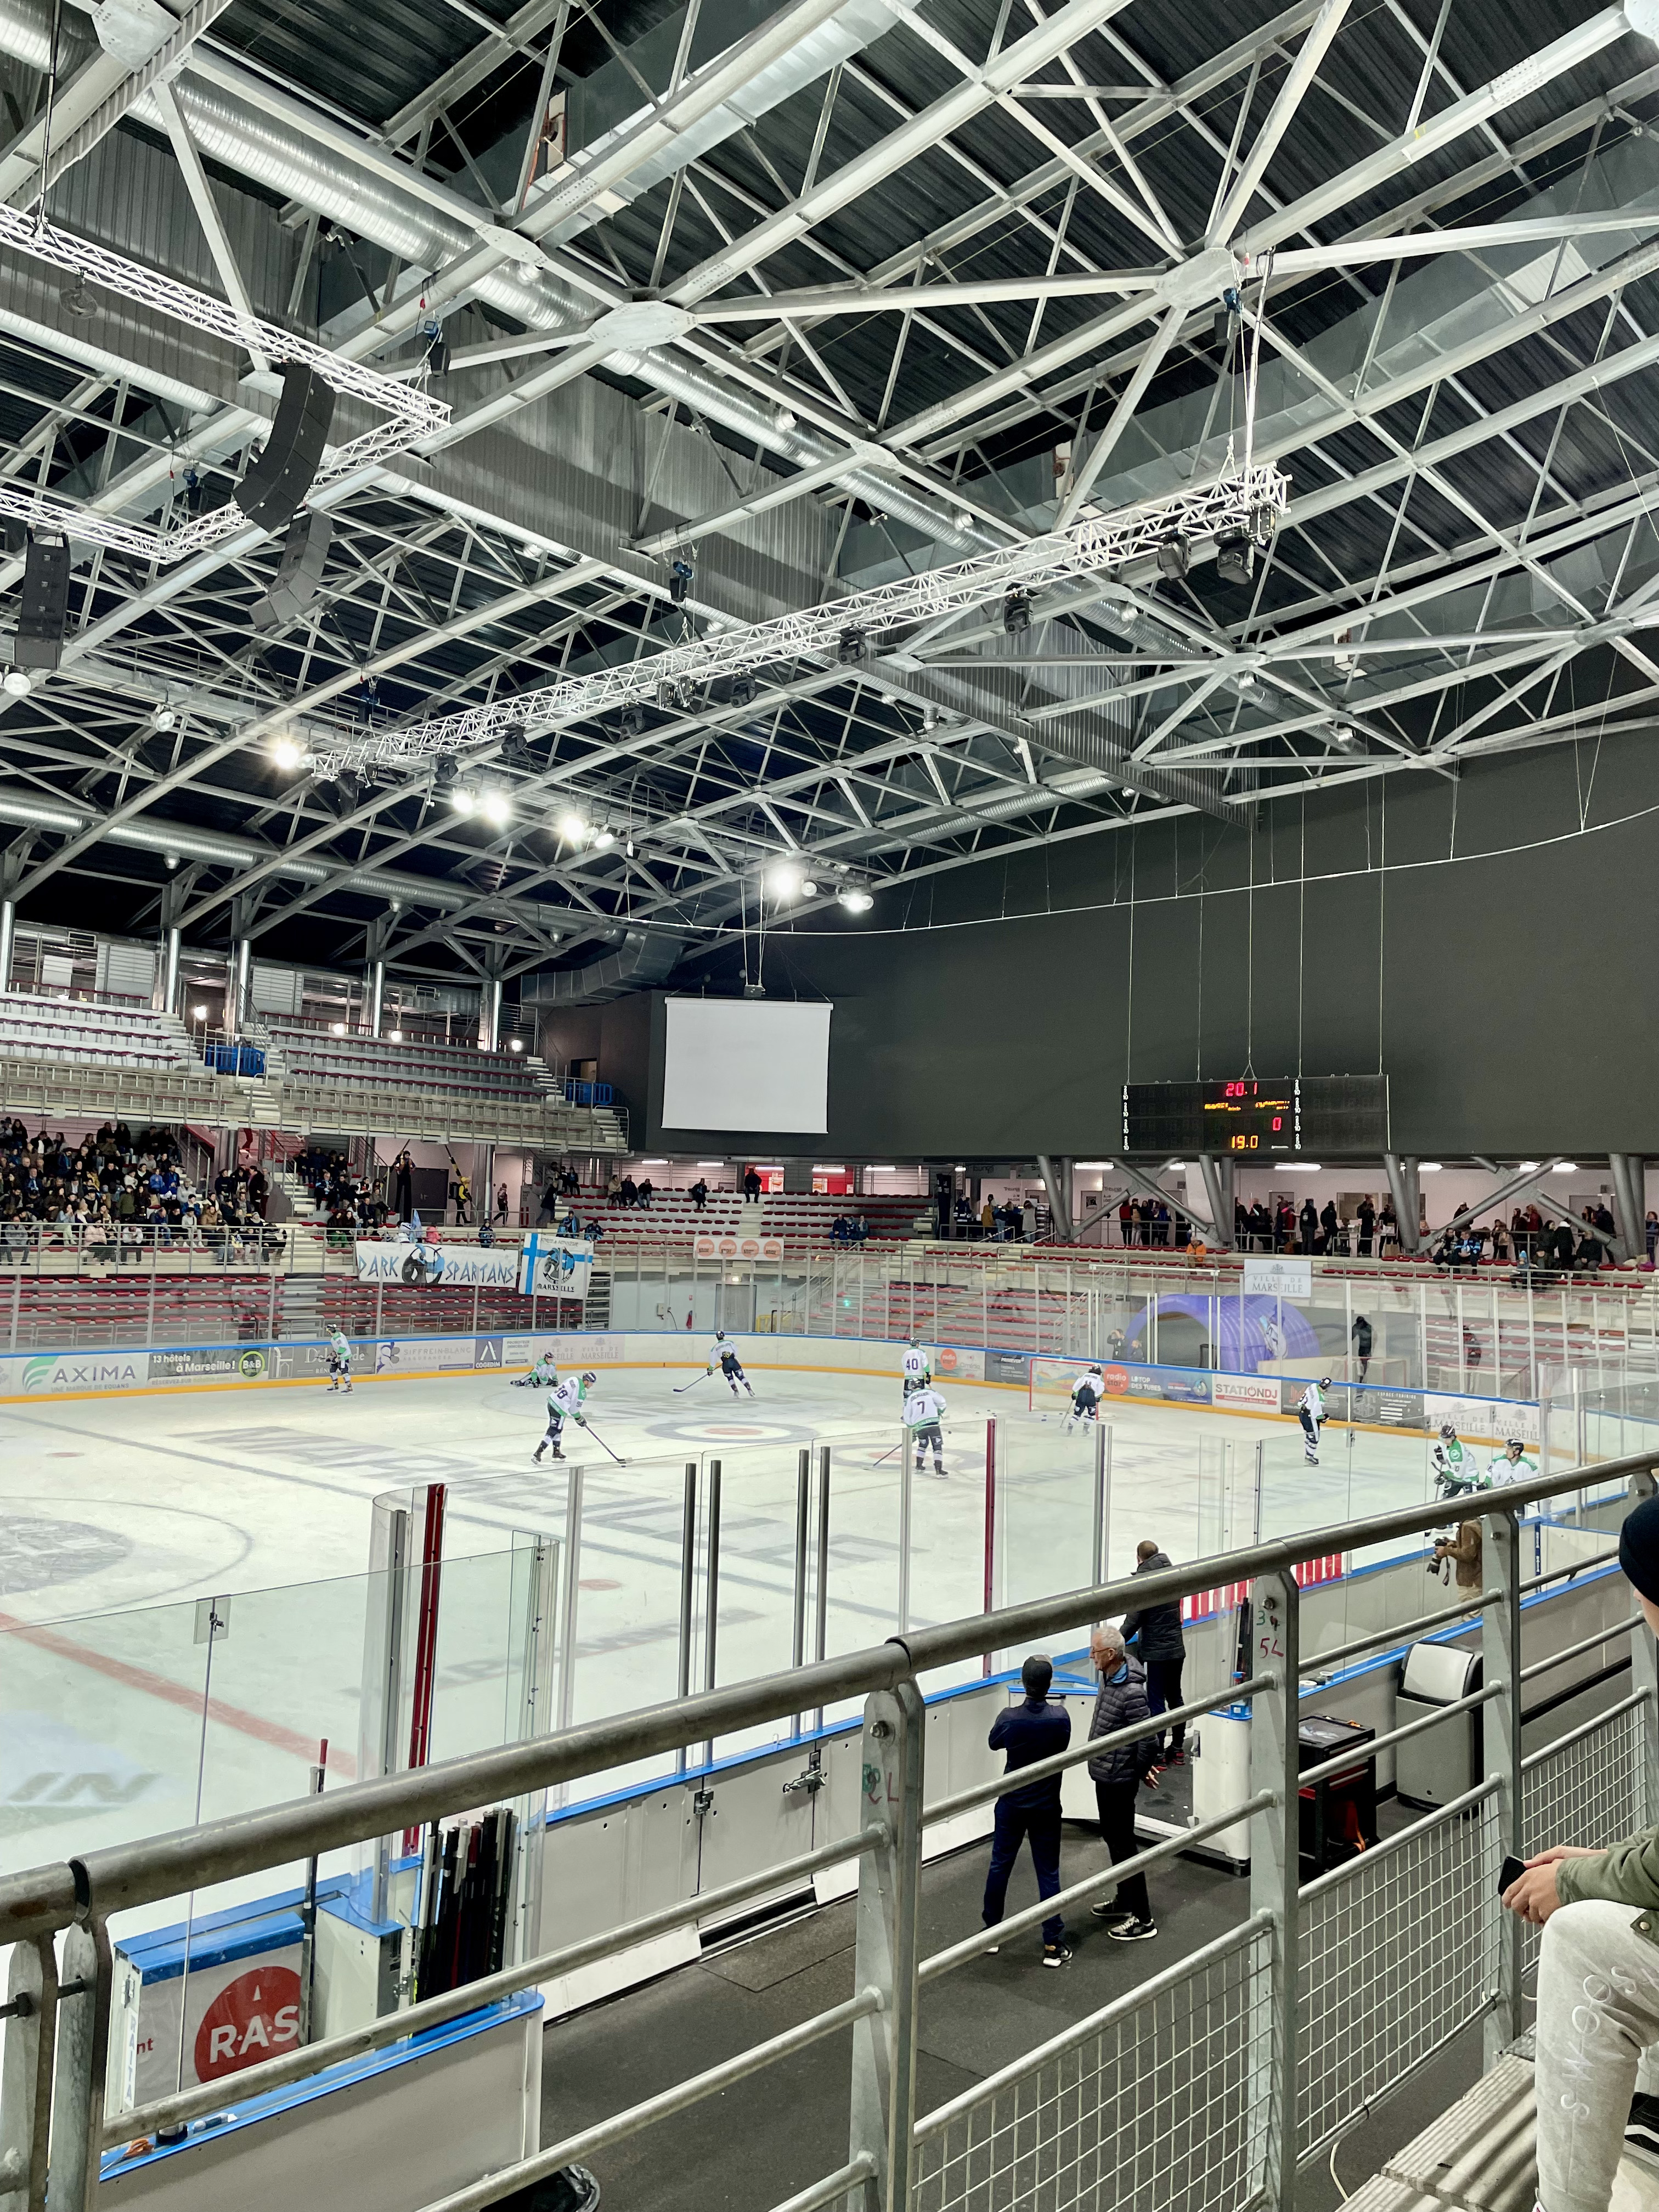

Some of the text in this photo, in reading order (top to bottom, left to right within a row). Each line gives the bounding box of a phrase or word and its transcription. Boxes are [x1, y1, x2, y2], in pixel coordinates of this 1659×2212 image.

[1272, 1116, 1282, 1131] 0
[1232, 1135, 1259, 1149] 19.0
[445, 1260, 515, 1284] SPARTANS
[153, 1354, 191, 1363] 13 hôtels
[580, 1351, 619, 1360] MARSEILLE
[176, 1364, 184, 1373] à
[185, 1360, 235, 1372] Marseille!
[242, 1359, 262, 1369] B&B
[906, 1358, 918, 1370] 40
[52, 1365, 136, 1383] AXIMA
[1106, 1373, 1126, 1381] radio
[917, 1401, 926, 1414] 7
[1495, 1426, 1539, 1441] MARSEILL
[126, 2015, 137, 2102] RAITA
